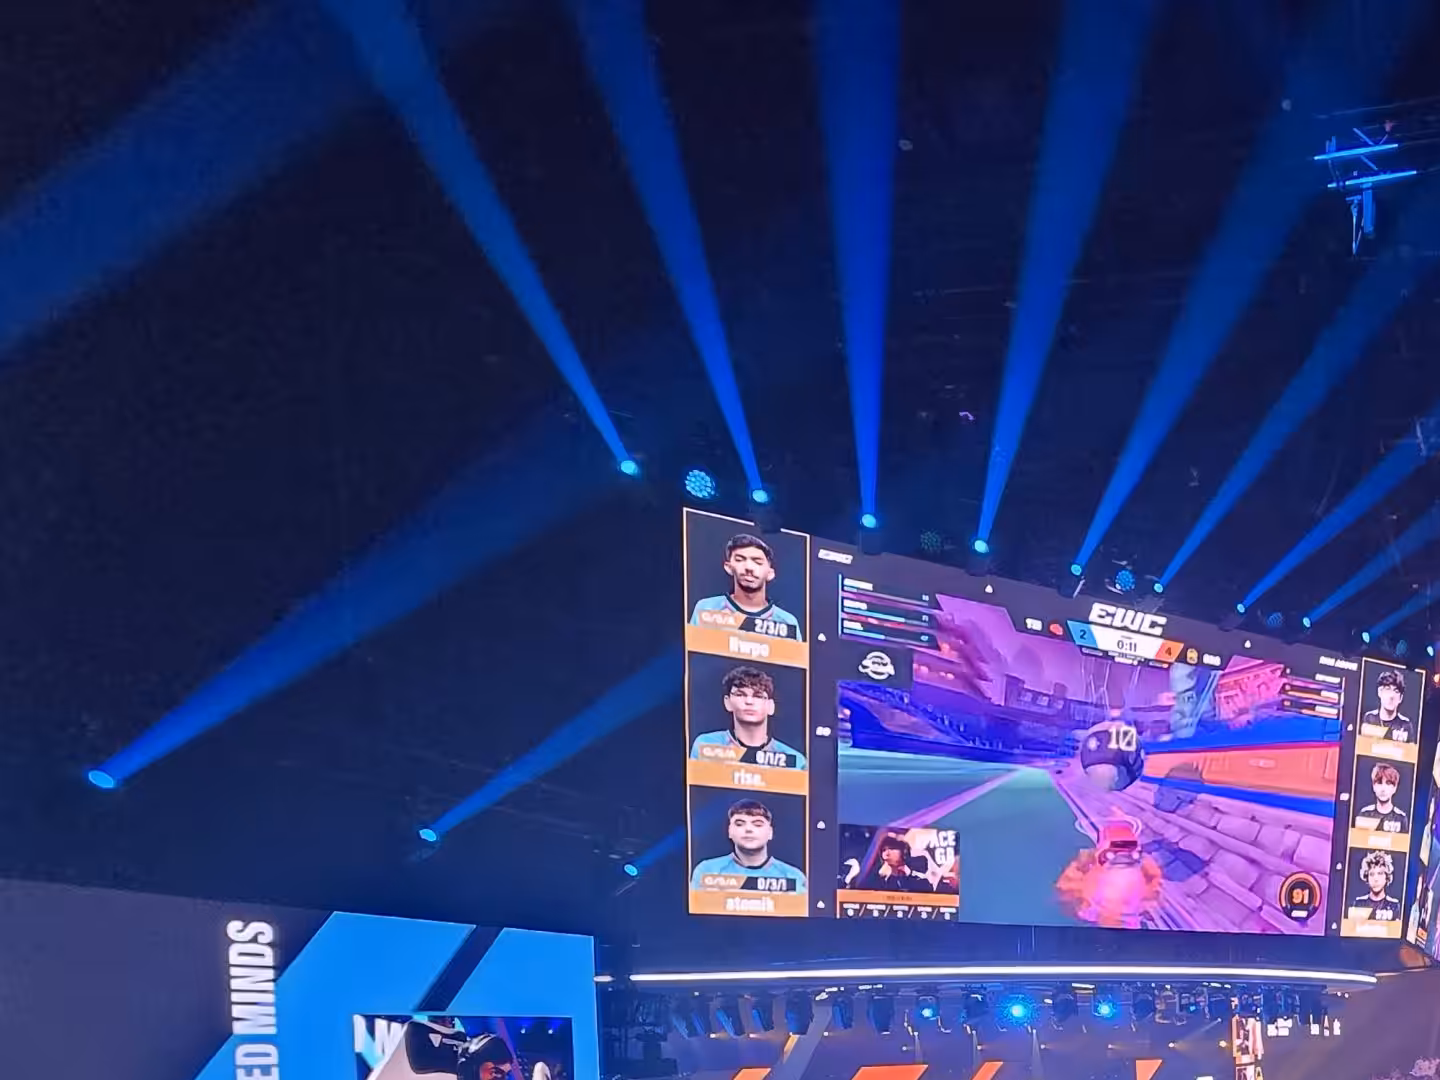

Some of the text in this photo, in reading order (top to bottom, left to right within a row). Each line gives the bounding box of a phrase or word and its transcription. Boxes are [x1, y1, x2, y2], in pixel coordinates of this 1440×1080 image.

[1088, 602, 1168, 636] EWC
[1079, 629, 1088, 641] 2
[1116, 639, 1138, 652] 0:11
[1164, 645, 1174, 657] 4
[1107, 725, 1137, 752] 10
[756, 877, 788, 891] 0/3/1
[1291, 888, 1312, 905] 91
[226, 919, 278, 1035] MINDS
